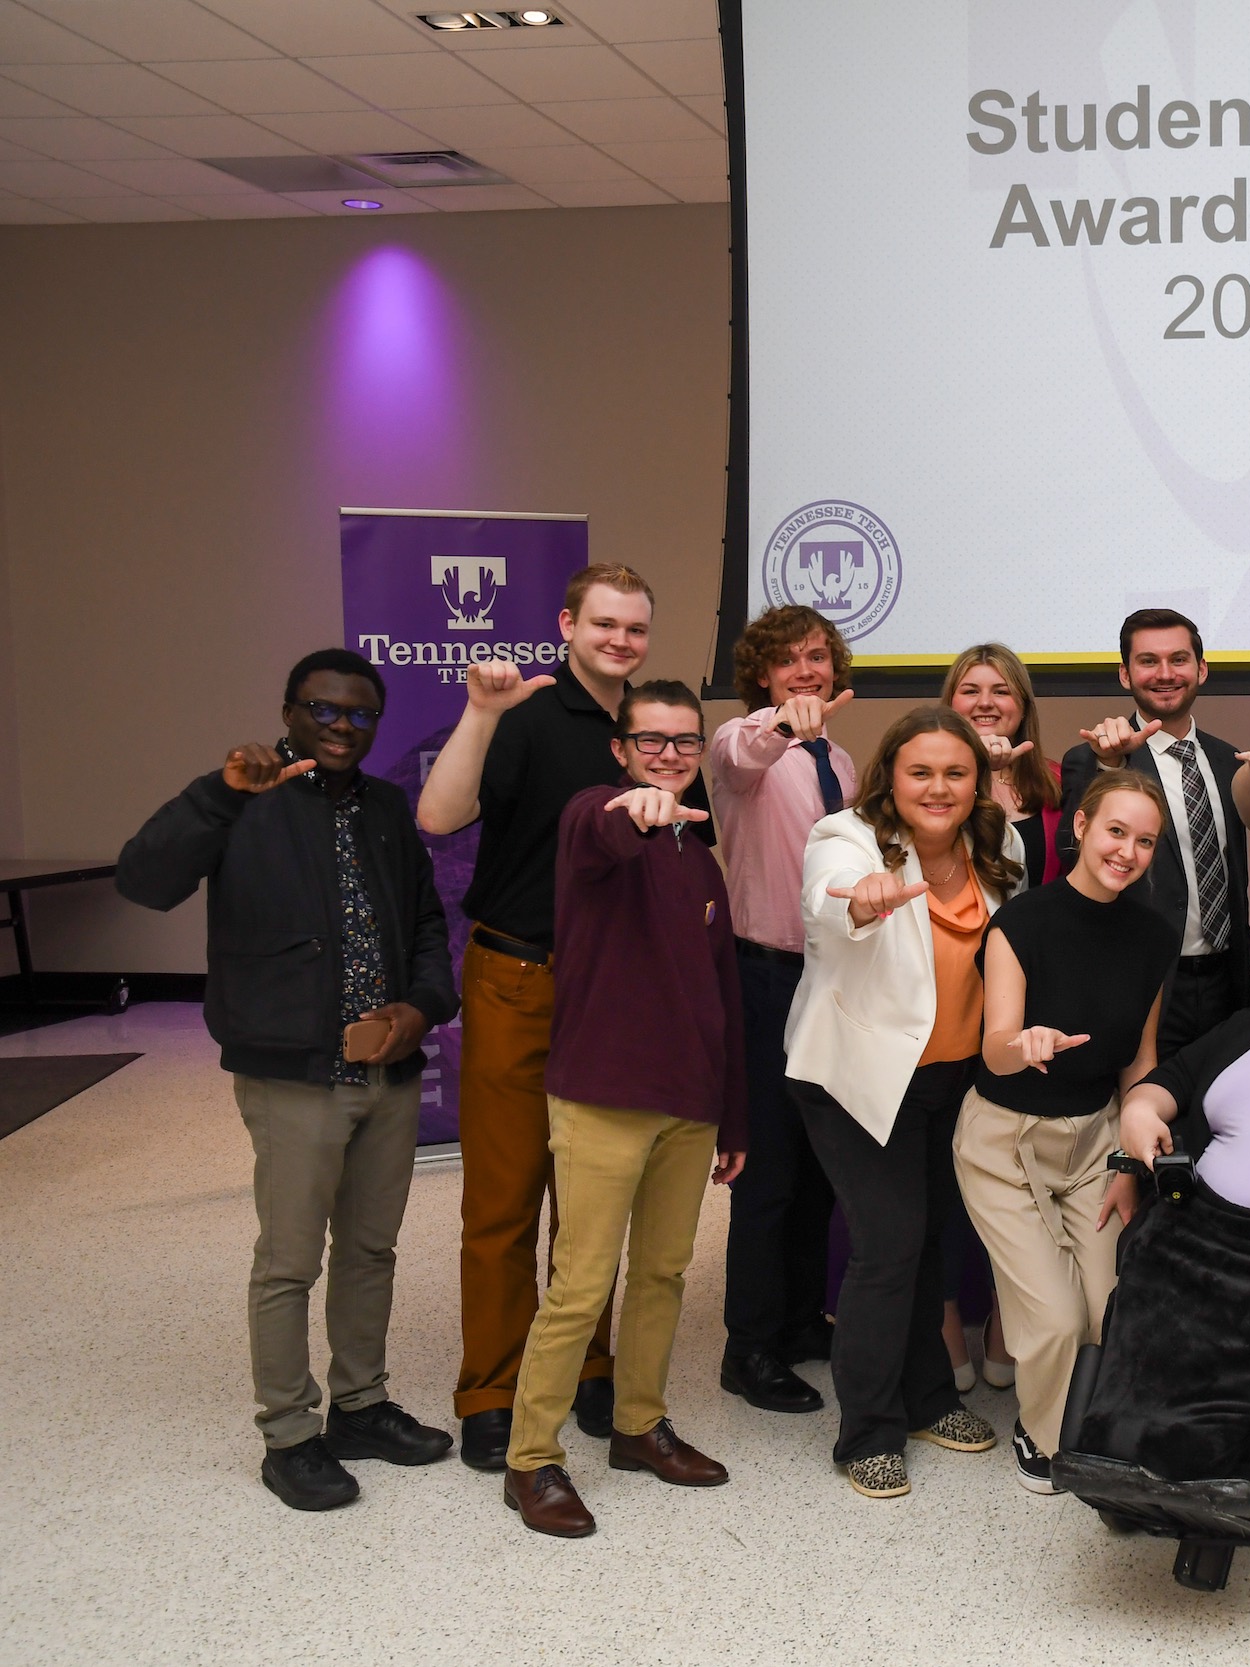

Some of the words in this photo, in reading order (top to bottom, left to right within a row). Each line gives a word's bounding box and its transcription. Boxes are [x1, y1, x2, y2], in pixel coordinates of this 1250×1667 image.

[773, 506, 855, 551] TENNESSEE
[857, 514, 891, 551] TECH
[857, 575, 894, 630] ASSOCIATION
[438, 668, 468, 684] TE
